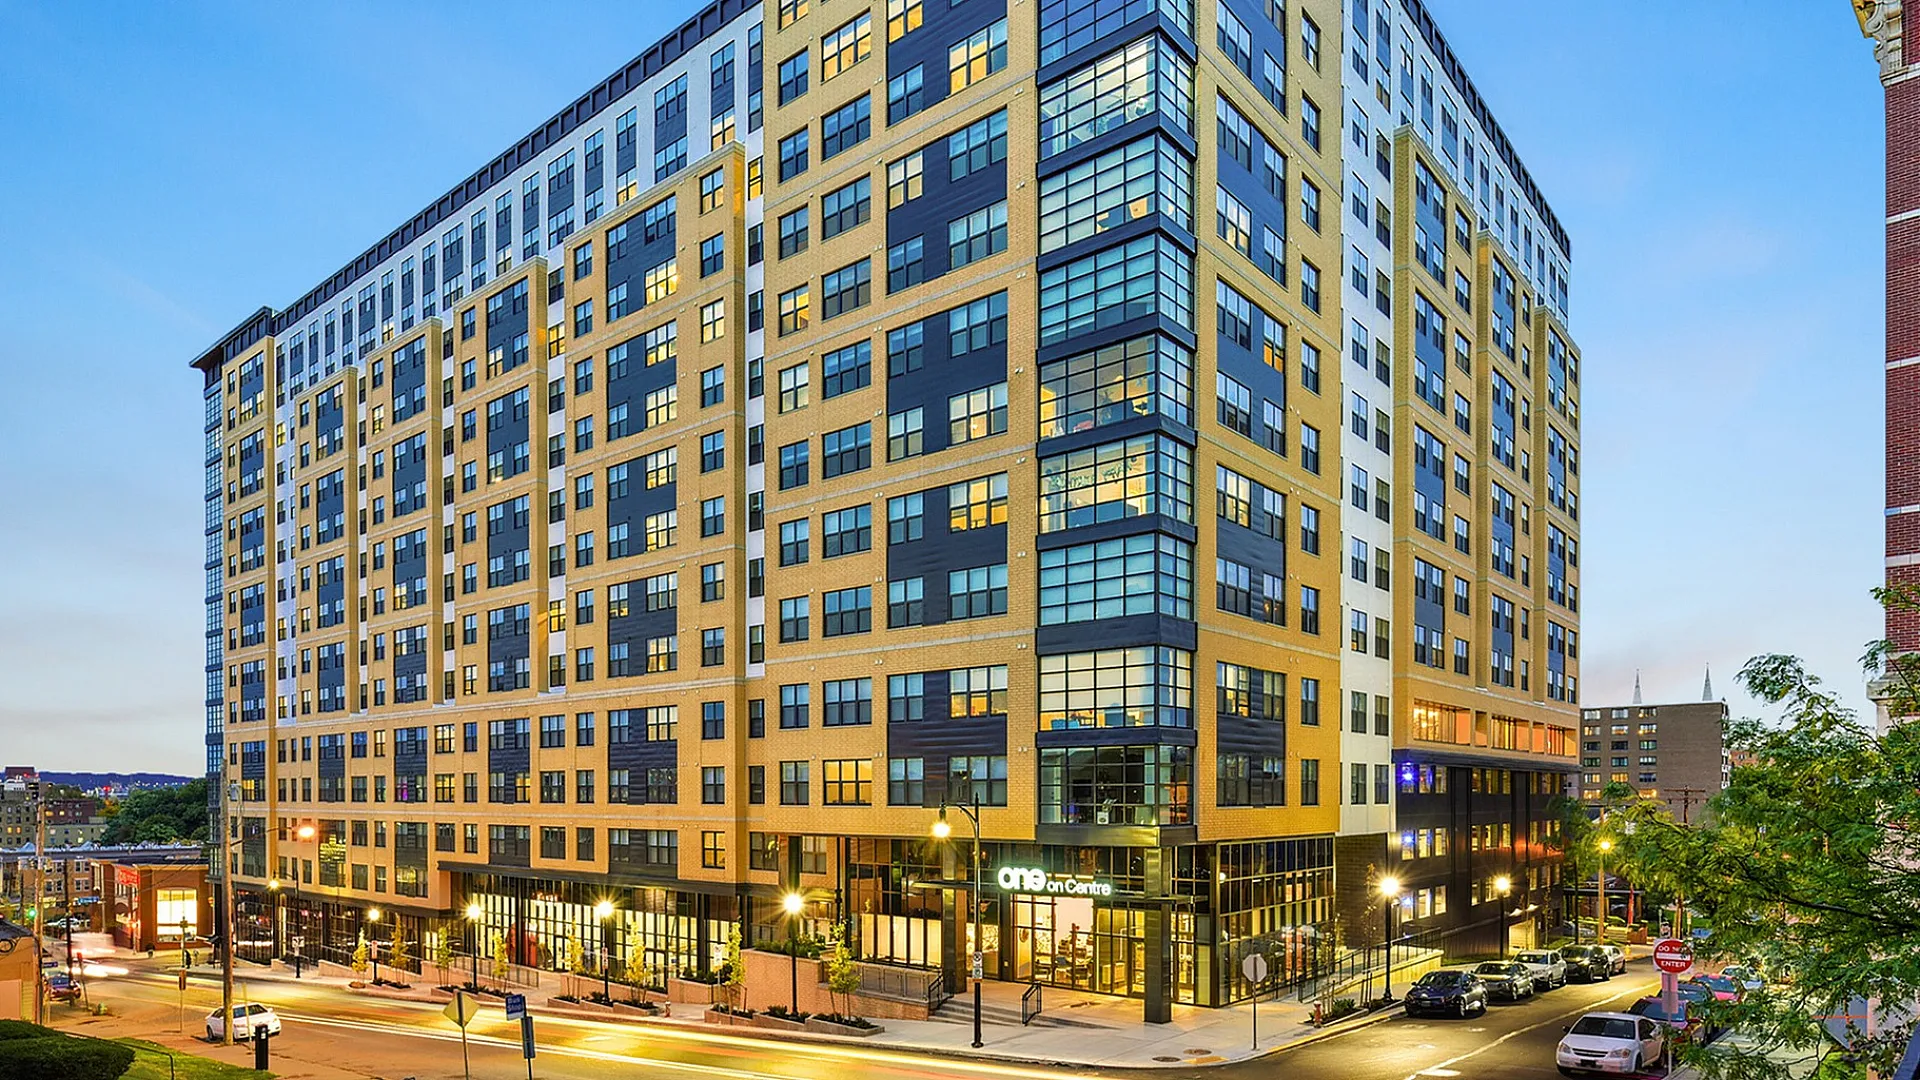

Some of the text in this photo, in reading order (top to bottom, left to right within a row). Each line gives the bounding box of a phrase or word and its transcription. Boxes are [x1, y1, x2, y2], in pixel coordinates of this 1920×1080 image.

[998, 866, 1111, 896] one on Centre
